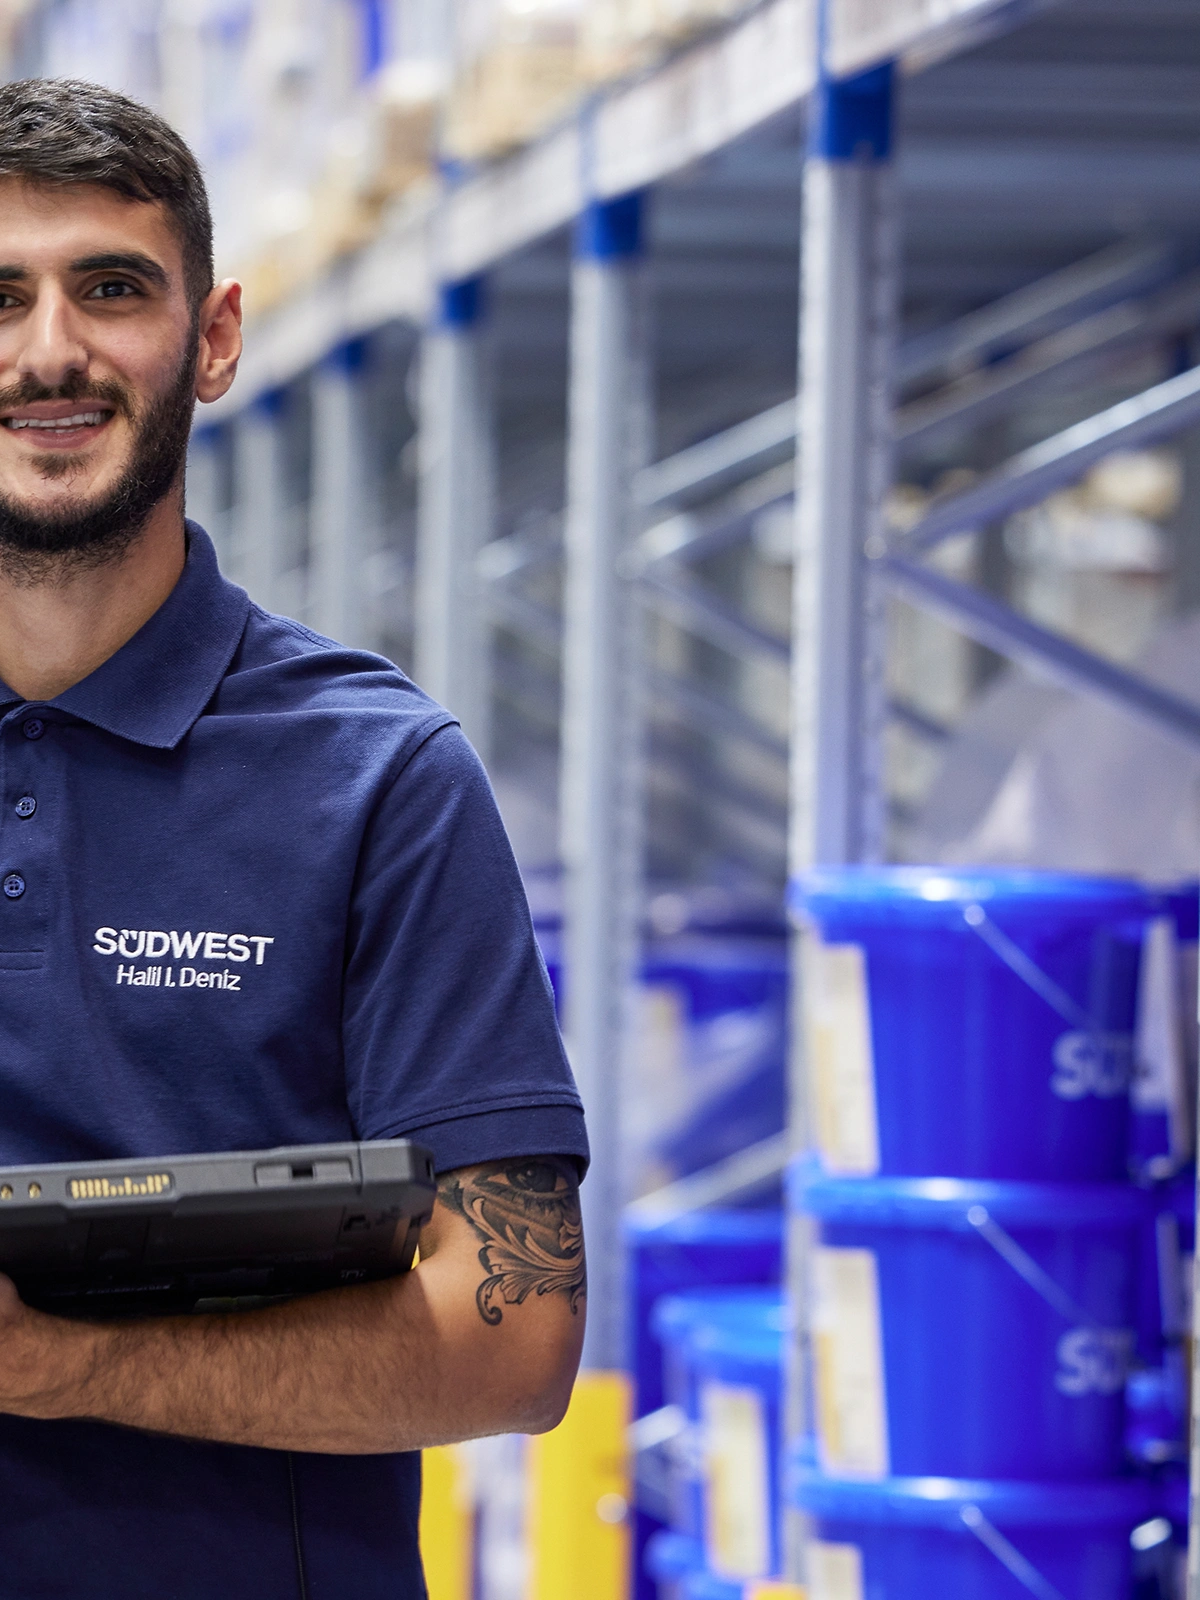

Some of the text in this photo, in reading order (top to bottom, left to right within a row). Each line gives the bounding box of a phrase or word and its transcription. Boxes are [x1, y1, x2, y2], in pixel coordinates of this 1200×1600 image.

[93, 926, 275, 965] SÜDWEST
[116, 964, 162, 987] Halil
[179, 967, 241, 991] Deniz
